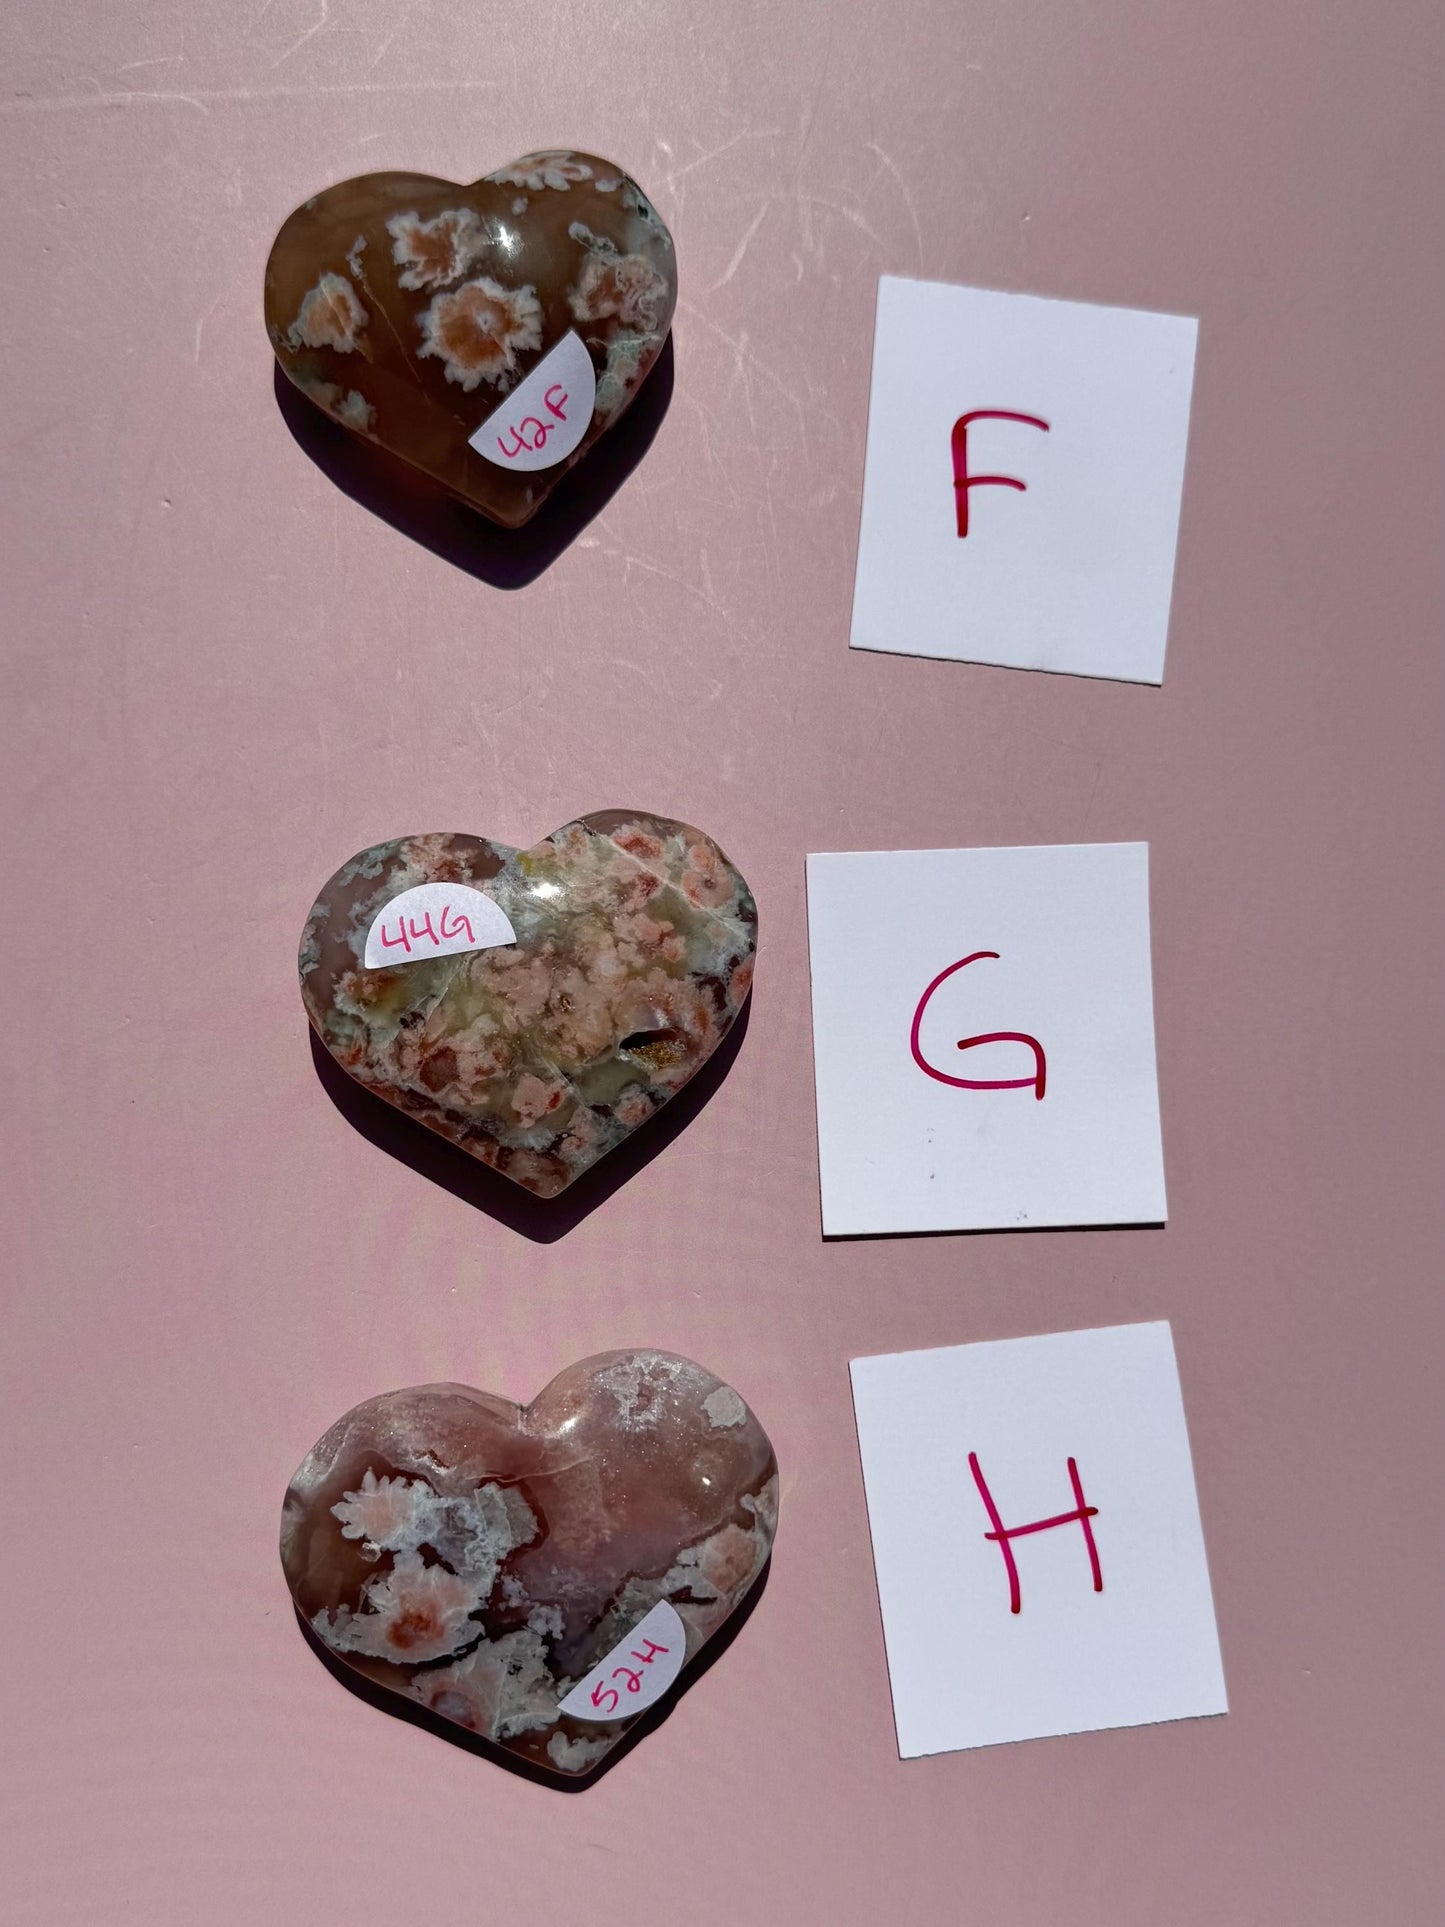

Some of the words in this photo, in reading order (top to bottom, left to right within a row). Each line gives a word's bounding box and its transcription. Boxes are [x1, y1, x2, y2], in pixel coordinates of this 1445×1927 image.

[497, 384, 569, 459] 42F
[950, 408, 1050, 539] F
[380, 904, 476, 953] 44G
[909, 951, 1048, 1102] G
[967, 1452, 1103, 1615] H
[590, 1638, 669, 1713] 52H
